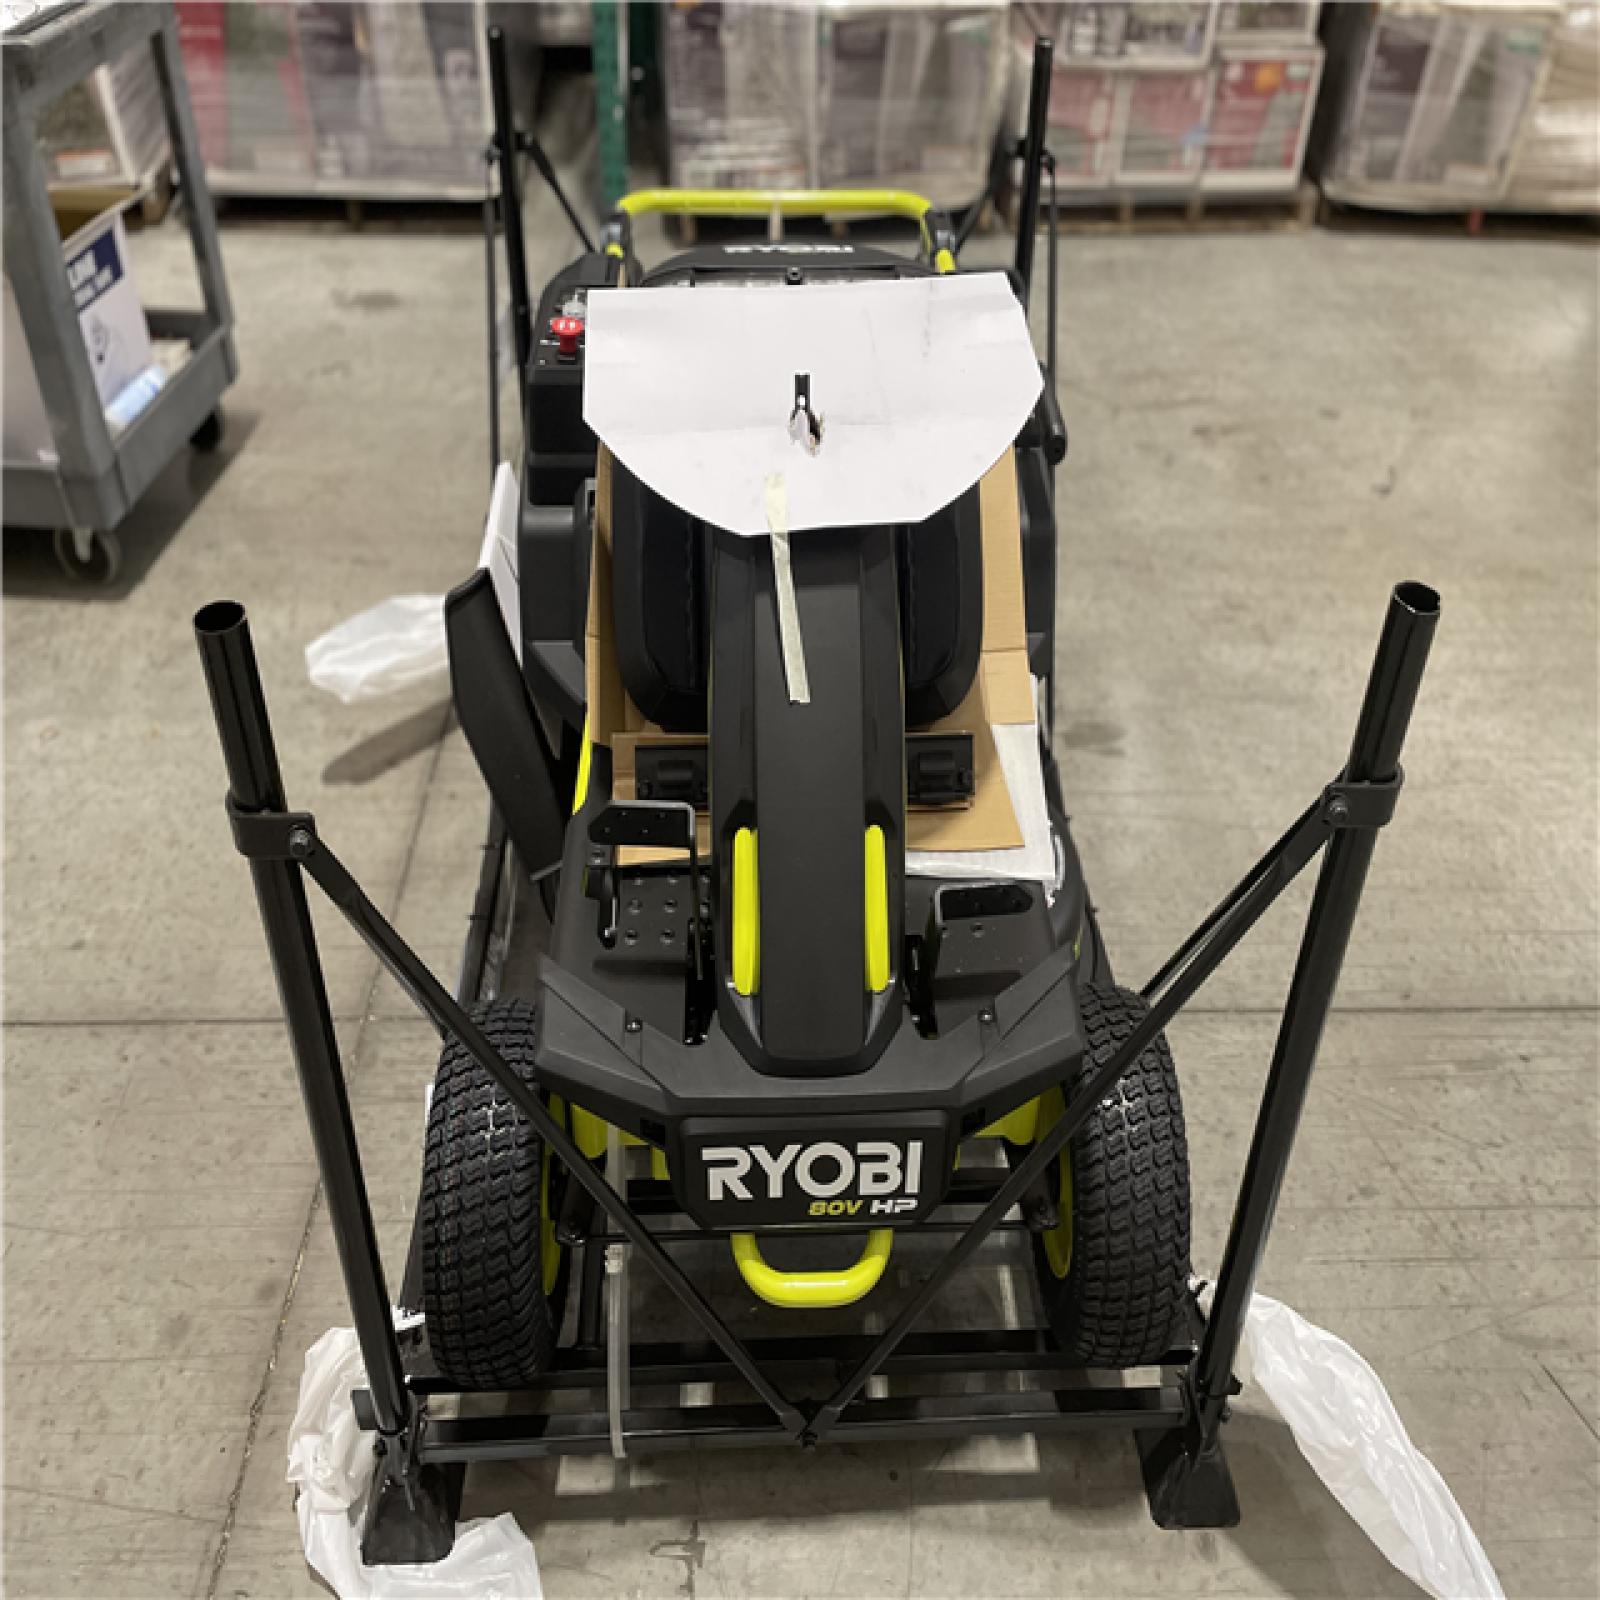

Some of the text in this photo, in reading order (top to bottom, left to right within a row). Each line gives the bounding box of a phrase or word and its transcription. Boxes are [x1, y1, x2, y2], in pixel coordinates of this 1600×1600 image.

[702, 1140, 923, 1201] RYOBI
[808, 1198, 918, 1216] 80V HP
